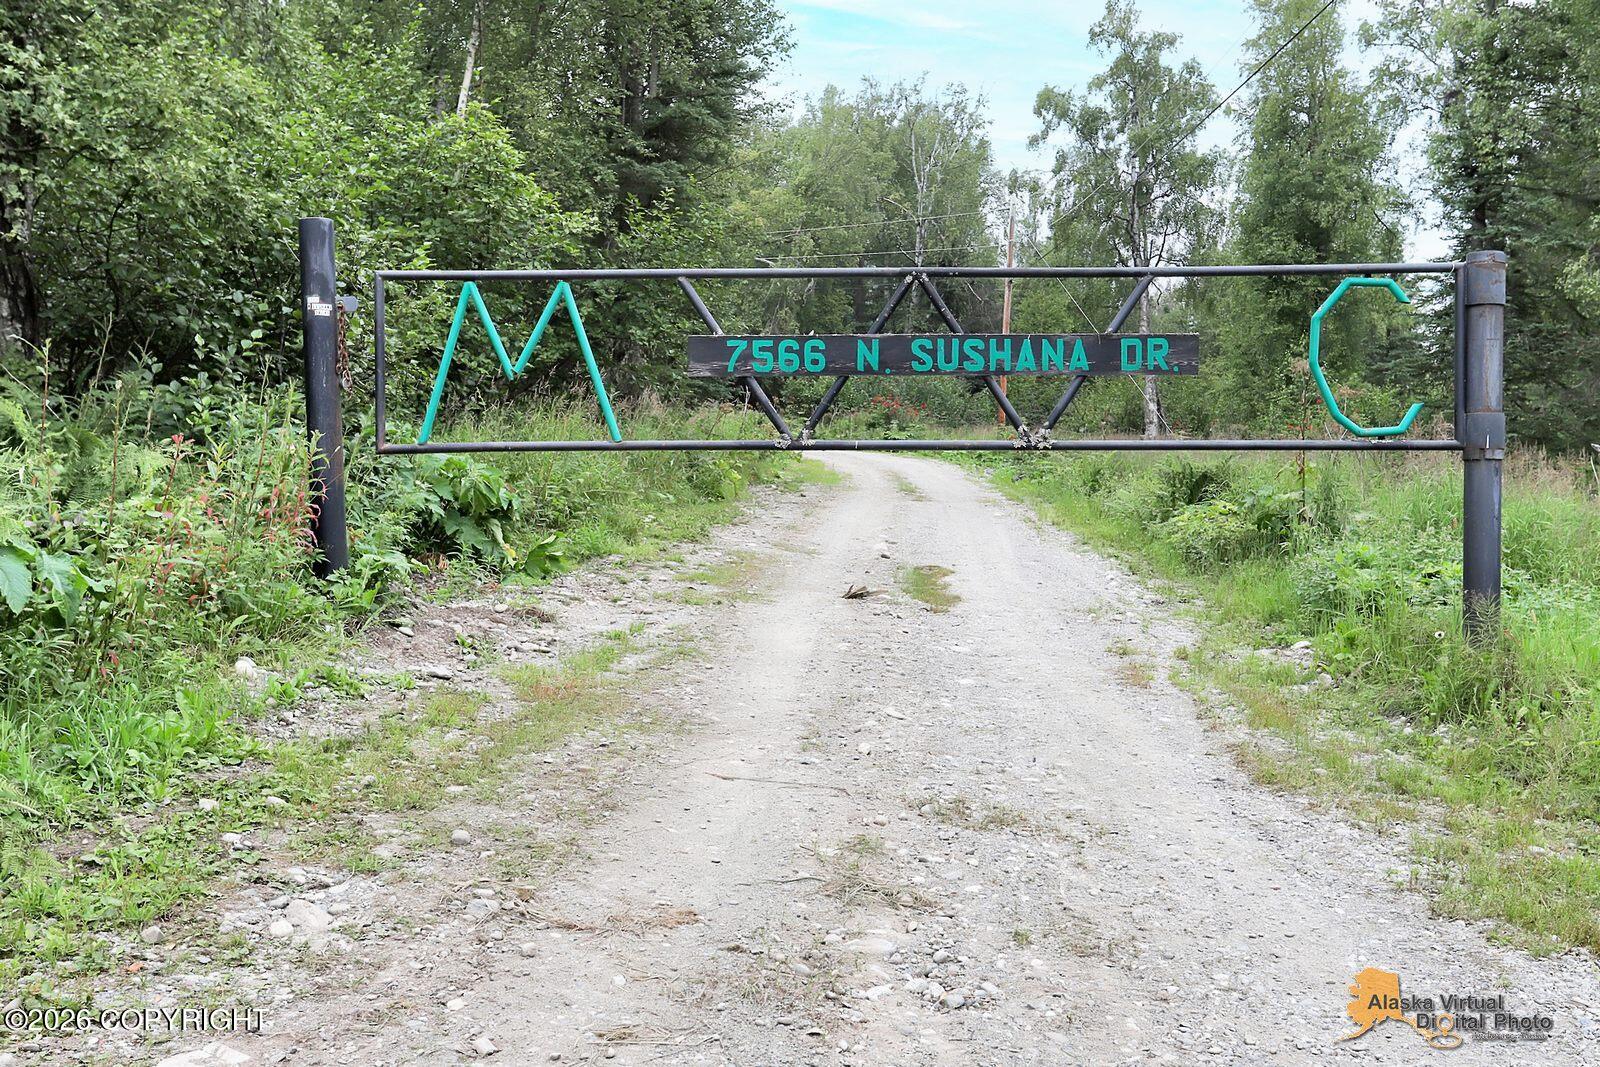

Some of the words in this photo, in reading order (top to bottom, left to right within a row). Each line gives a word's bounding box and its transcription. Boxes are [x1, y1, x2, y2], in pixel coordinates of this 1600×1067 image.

[726, 339, 826, 373] 7566
[857, 339, 891, 374] N.
[910, 338, 1090, 372] SUSHANA
[1120, 338, 1180, 372] DR.
